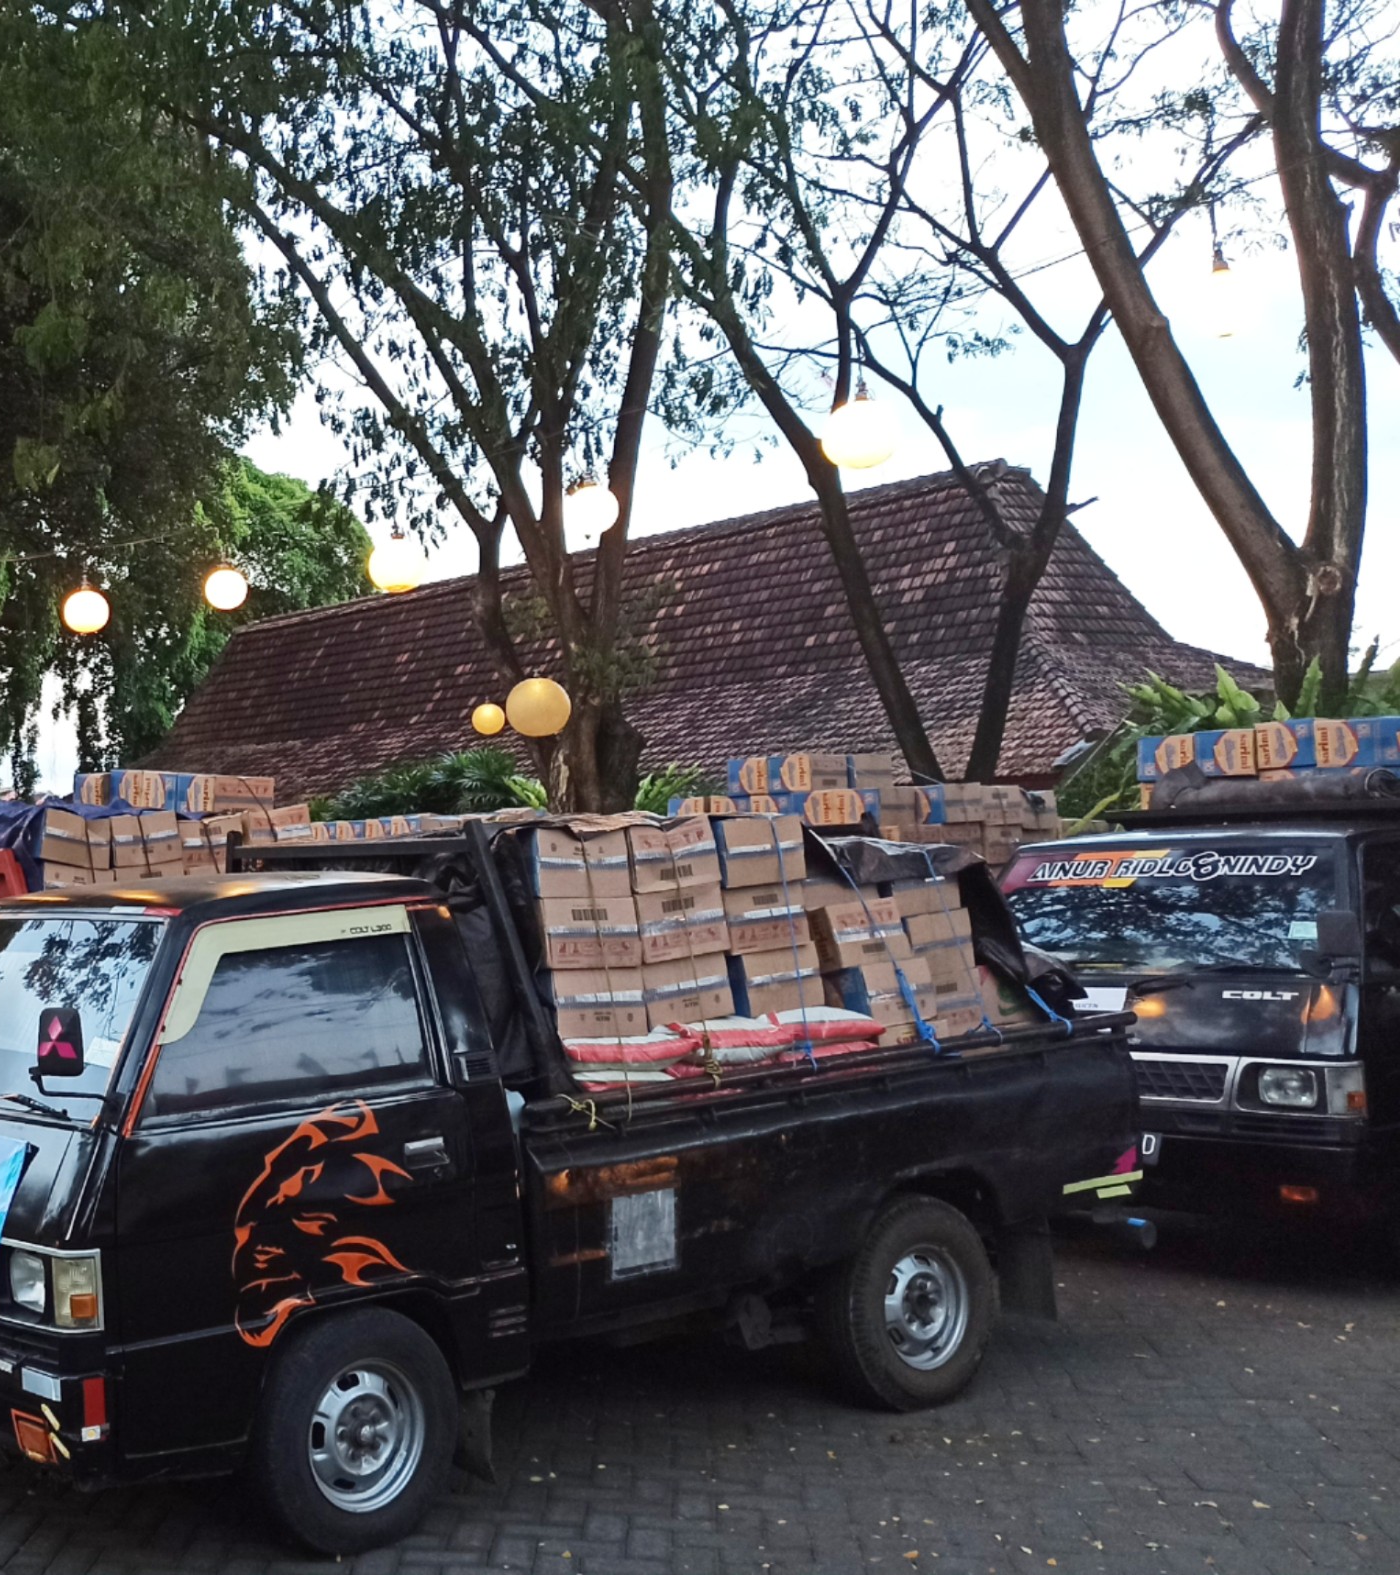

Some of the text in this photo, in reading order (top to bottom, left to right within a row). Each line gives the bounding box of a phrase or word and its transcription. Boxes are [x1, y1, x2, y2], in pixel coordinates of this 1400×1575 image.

[1240, 733, 1250, 770] sarimi
[1257, 729, 1271, 766] sarimi
[1317, 727, 1330, 764] sarimi
[1027, 858, 1112, 882] AINUR
[1222, 990, 1299, 1000] COLT
[1142, 1134, 1156, 1154] D
